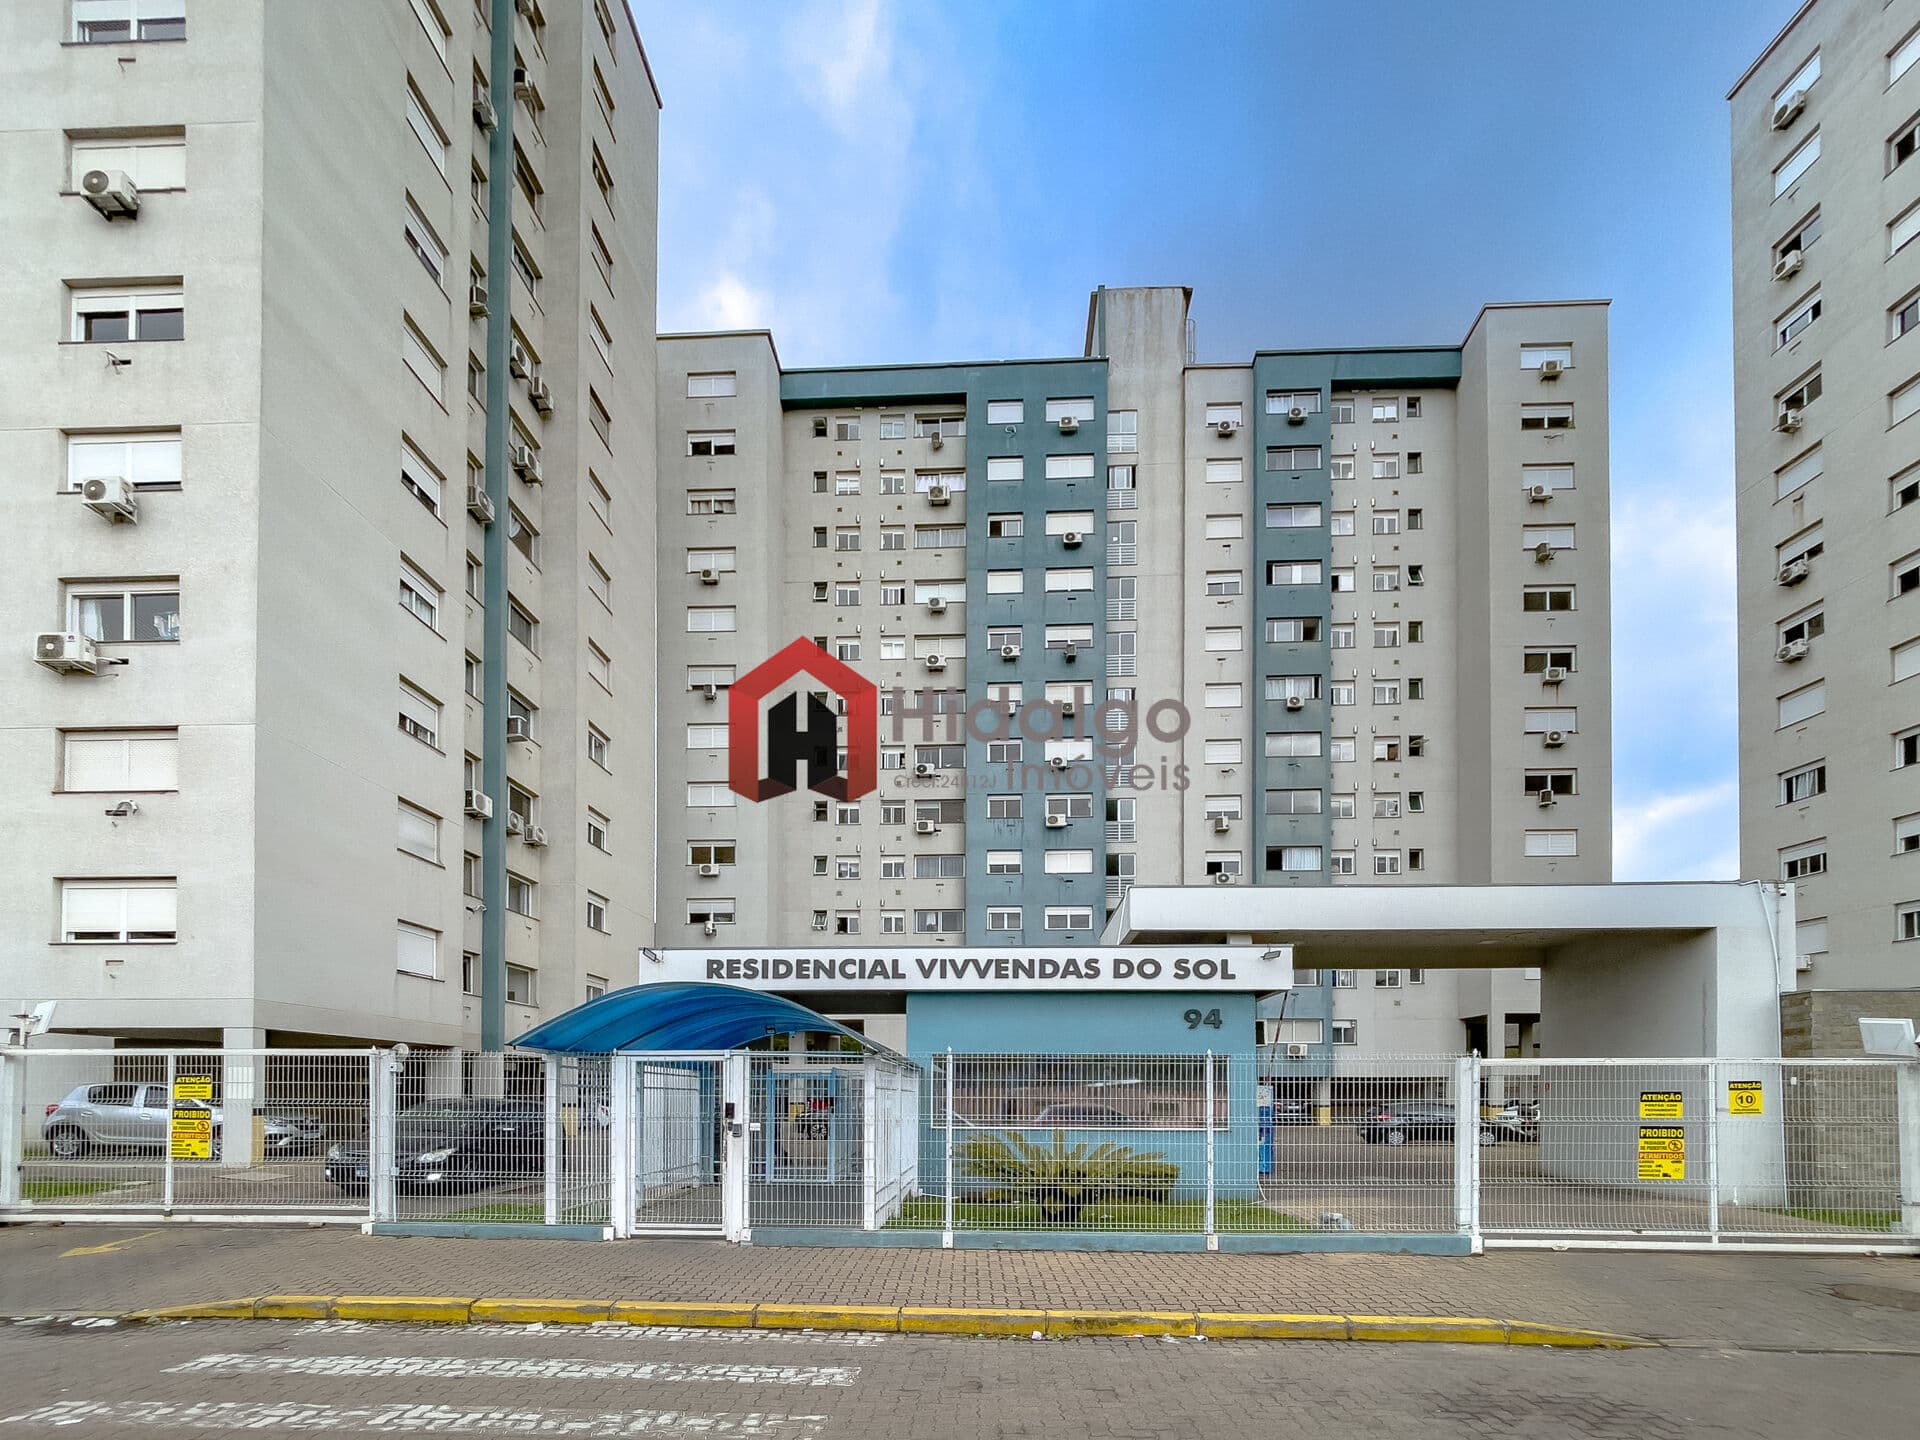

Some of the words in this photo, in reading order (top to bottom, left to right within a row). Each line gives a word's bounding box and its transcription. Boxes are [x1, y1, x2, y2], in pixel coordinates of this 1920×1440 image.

[706, 958, 906, 980] RESIDENCIAL
[915, 958, 1101, 980] VIVVENDAS
[1113, 958, 1162, 980] DO
[1173, 958, 1236, 980] SOL
[1183, 1008, 1223, 1030] 94
[1642, 1093, 1681, 1101] ATENÇÃO
[1738, 1095, 1753, 1104] 10
[173, 1110, 211, 1119] PROIBIDO
[1640, 1128, 1684, 1138] PROIBIDO
[1639, 1152, 1684, 1160] PERMITIDOS
